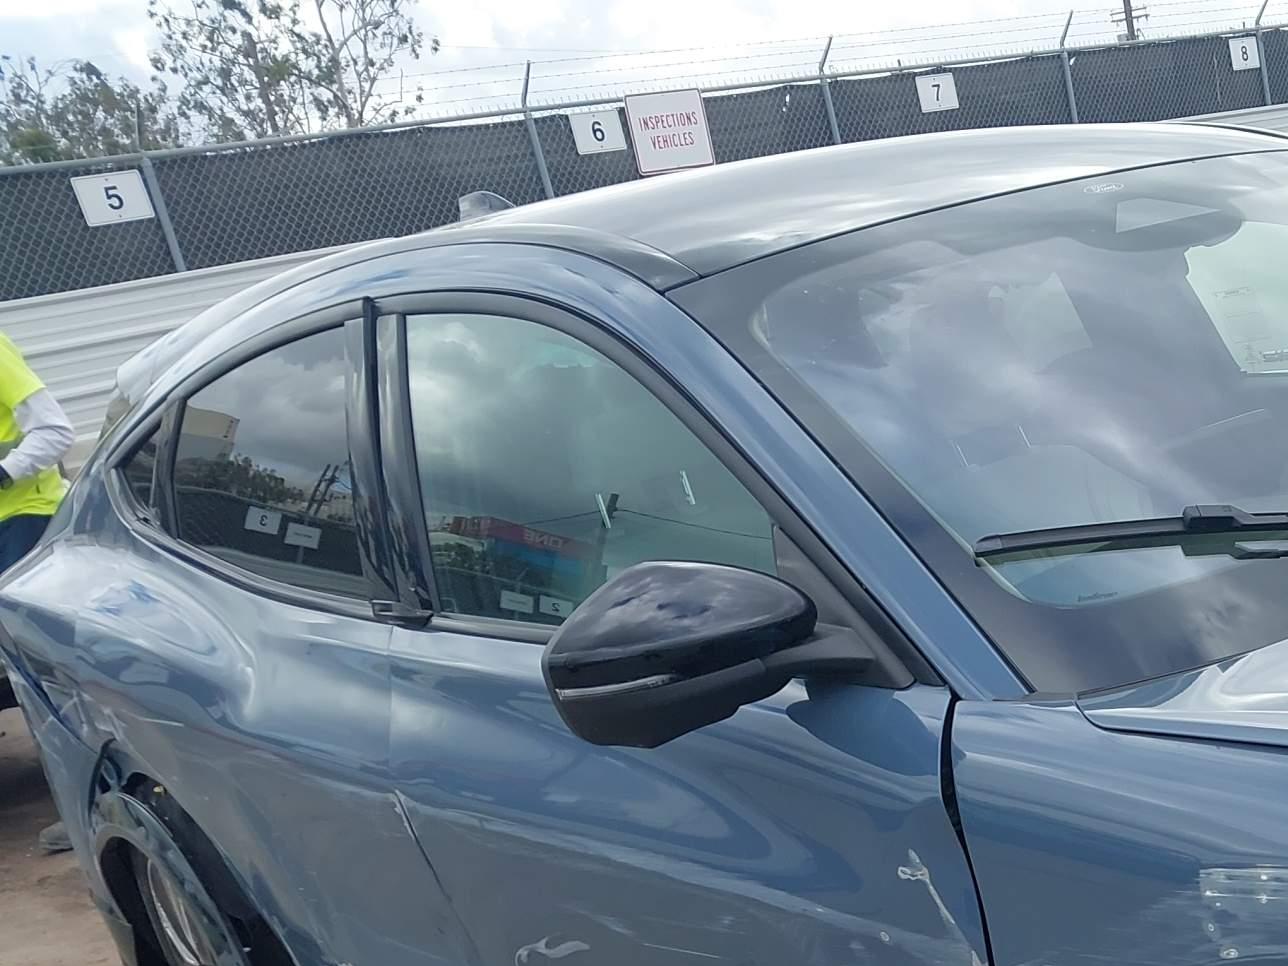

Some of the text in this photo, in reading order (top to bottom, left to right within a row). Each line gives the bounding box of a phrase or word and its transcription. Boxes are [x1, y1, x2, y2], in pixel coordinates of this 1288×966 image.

[1240, 45, 1249, 62] 8
[931, 83, 941, 102] 7
[591, 120, 606, 142] 6
[638, 111, 698, 132] INSPECTIONS
[650, 131, 695, 150] VEHICLES
[103, 185, 125, 210] 5
